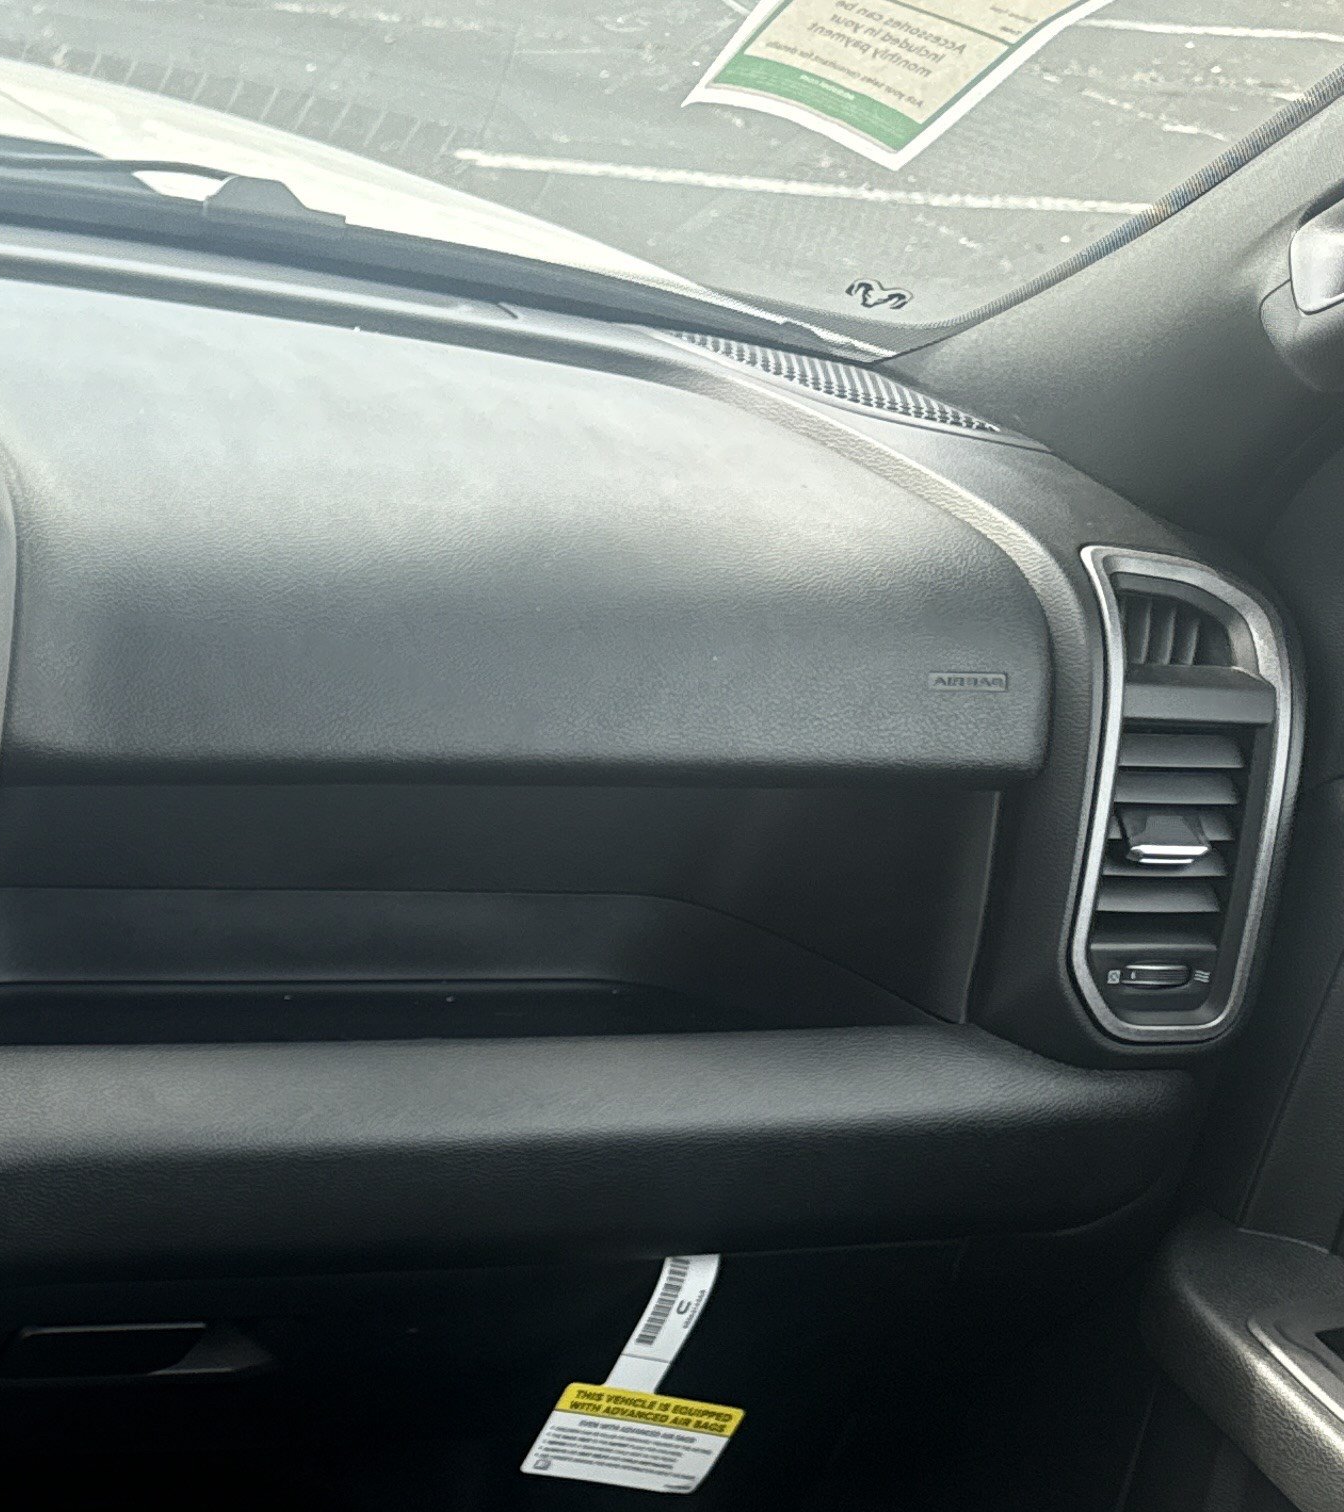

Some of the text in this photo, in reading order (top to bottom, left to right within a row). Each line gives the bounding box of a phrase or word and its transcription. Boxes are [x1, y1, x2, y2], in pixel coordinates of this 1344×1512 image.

[569, 1400, 728, 1434] WITH ADVANCED AIR BAGS
[574, 1388, 734, 1423] THIS VEHICLE IS EQUIPPED
